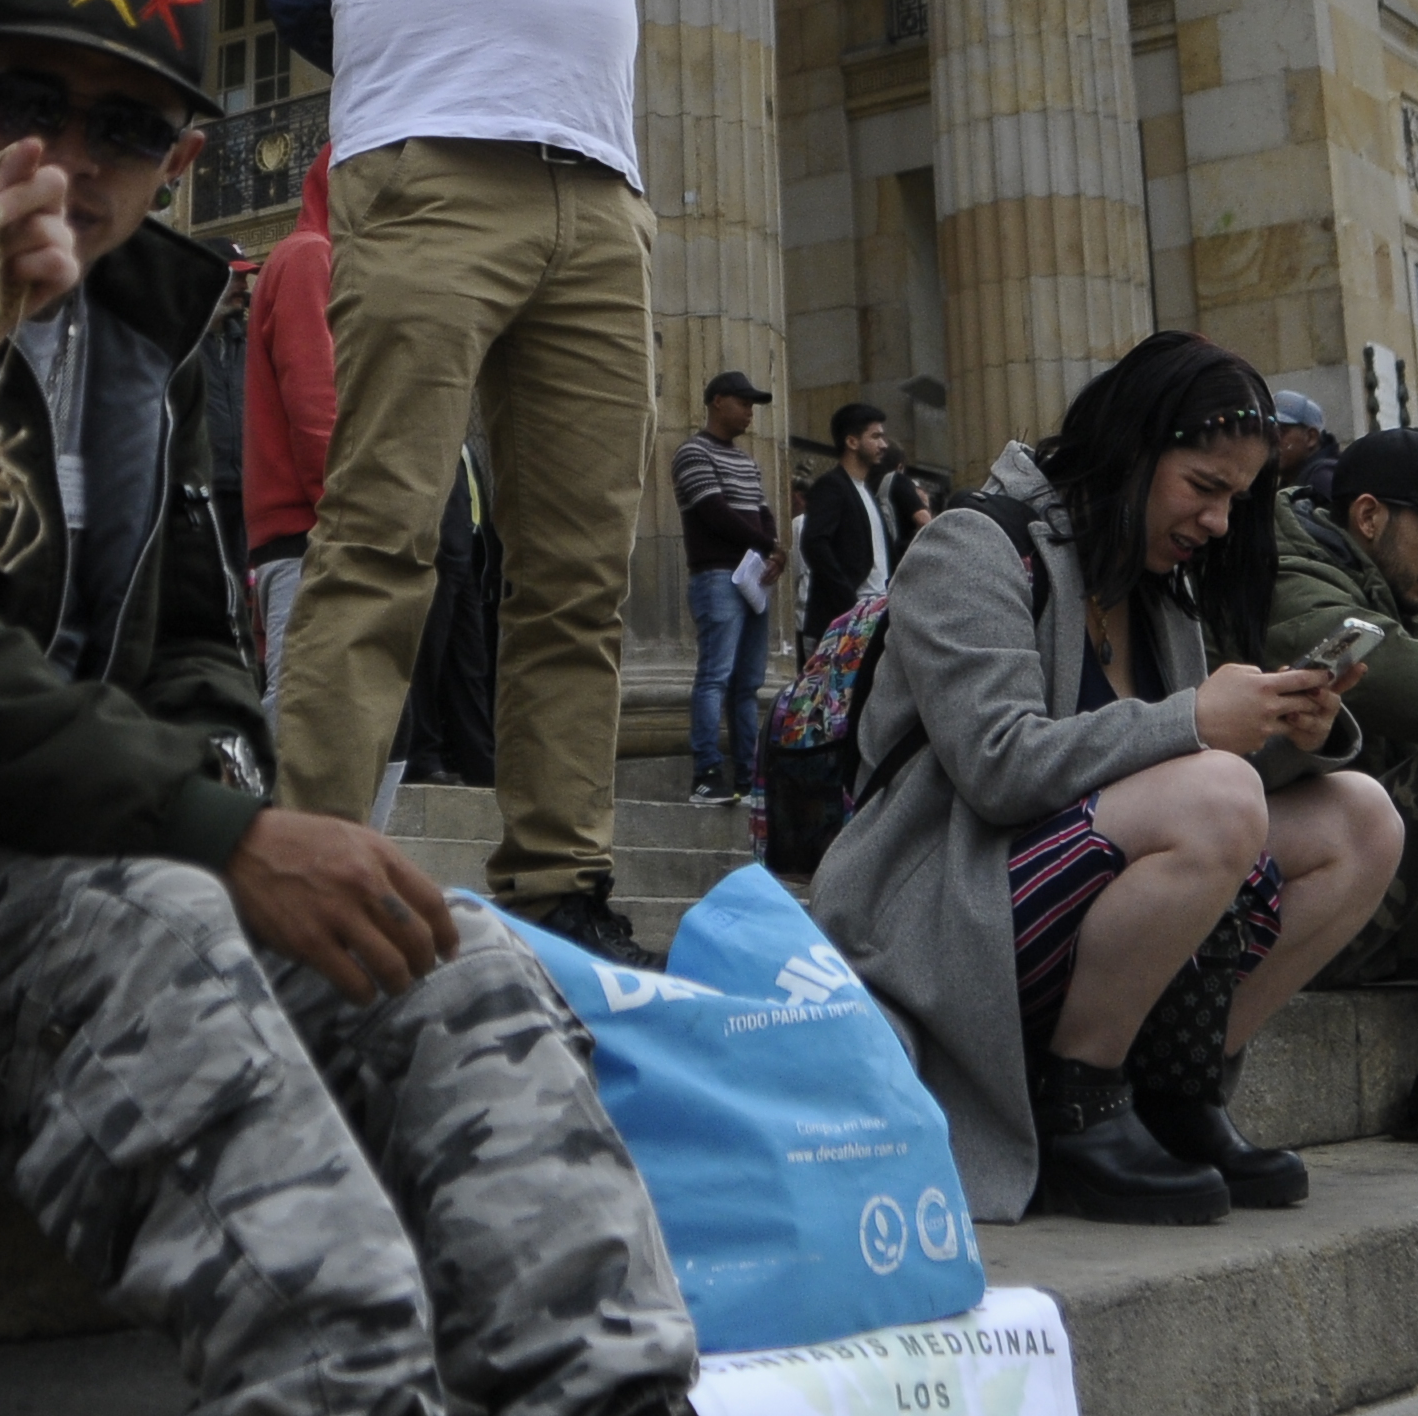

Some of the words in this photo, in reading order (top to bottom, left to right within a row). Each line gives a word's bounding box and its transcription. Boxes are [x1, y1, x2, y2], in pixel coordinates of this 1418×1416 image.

[724, 1012, 768, 1038] ¡TODO
[771, 1007, 808, 1026] PARA
[895, 1328, 1056, 1358] MEDICINAL
[894, 1382, 952, 1411] LOS
